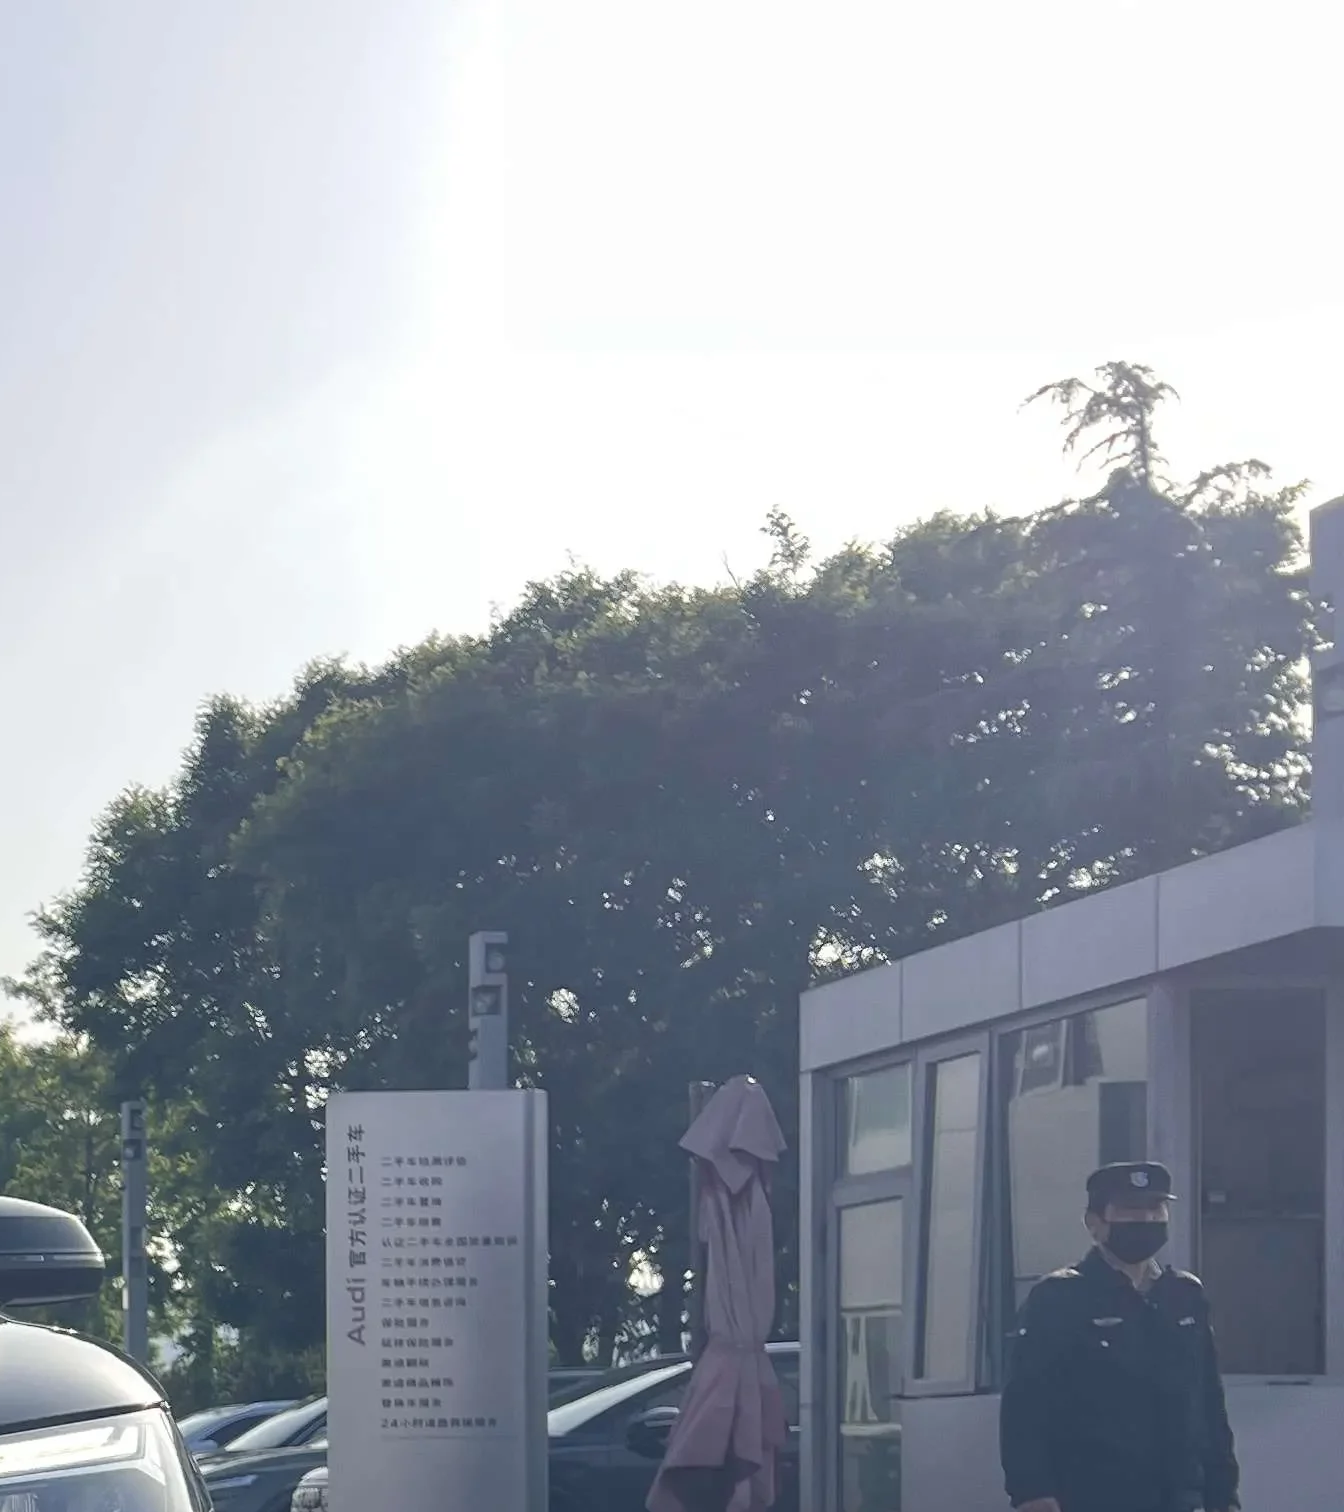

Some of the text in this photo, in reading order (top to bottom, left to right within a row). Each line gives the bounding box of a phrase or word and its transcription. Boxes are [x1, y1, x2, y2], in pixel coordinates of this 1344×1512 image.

[347, 1123, 366, 1346] Audi 官方认证二手车
